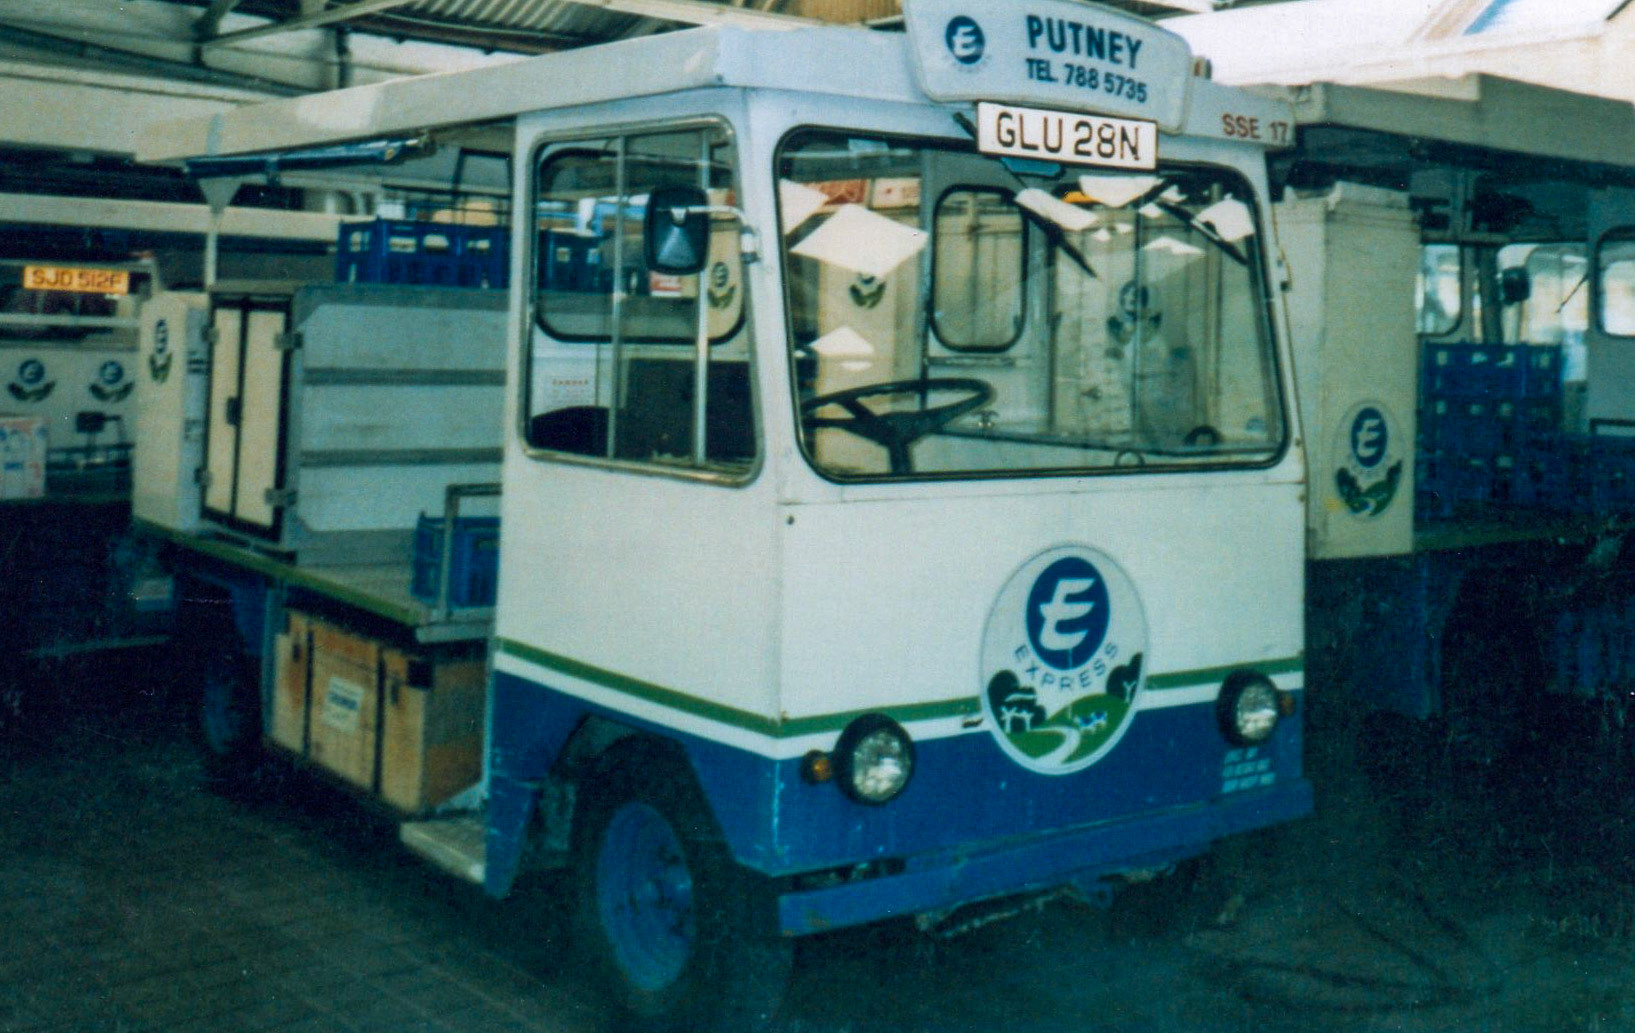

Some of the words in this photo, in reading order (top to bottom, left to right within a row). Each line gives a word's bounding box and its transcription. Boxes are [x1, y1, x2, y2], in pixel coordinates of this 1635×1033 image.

[1026, 14, 1143, 69] PUTNEY
[1064, 62, 1100, 90] 788
[1104, 71, 1148, 104] 5735
[997, 111, 1064, 154] GLU
[1074, 119, 1141, 161] 28N
[1222, 113, 1261, 140] SSE
[1269, 120, 1289, 143] 17
[1014, 642, 1117, 692] EXPRESS
